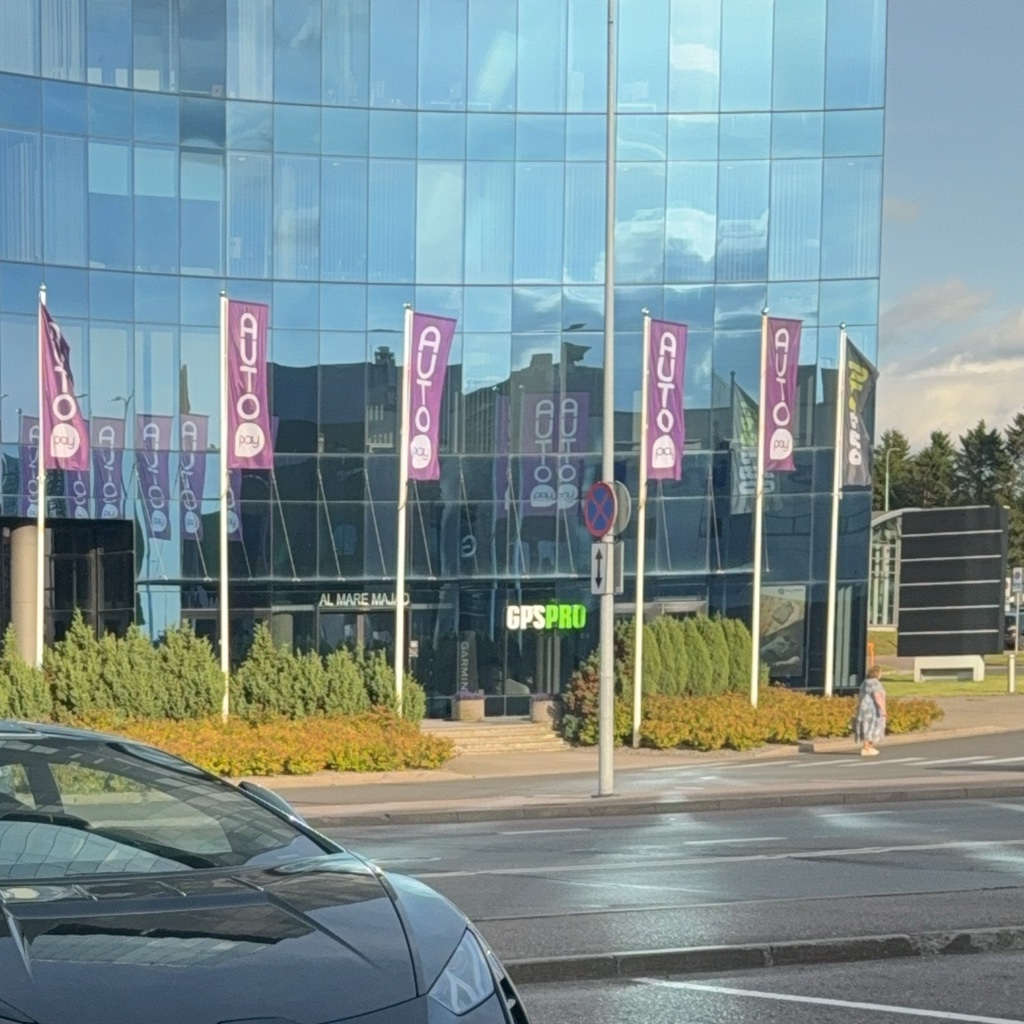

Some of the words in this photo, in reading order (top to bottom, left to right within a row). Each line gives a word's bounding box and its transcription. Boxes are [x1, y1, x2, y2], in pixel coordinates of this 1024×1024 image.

[237, 312, 260, 421] AUTO
[415, 325, 442, 433] AUTO
[656, 331, 677, 433] AUTO
[773, 328, 791, 426] AUTO
[51, 434, 75, 450] pay
[238, 434, 260, 448] pay
[773, 438, 791, 452] pay
[318, 592, 334, 607] AL
[336, 592, 369, 606] MARE
[506, 604, 587, 630] GPSPRO
[460, 641, 469, 690] GARMIN
